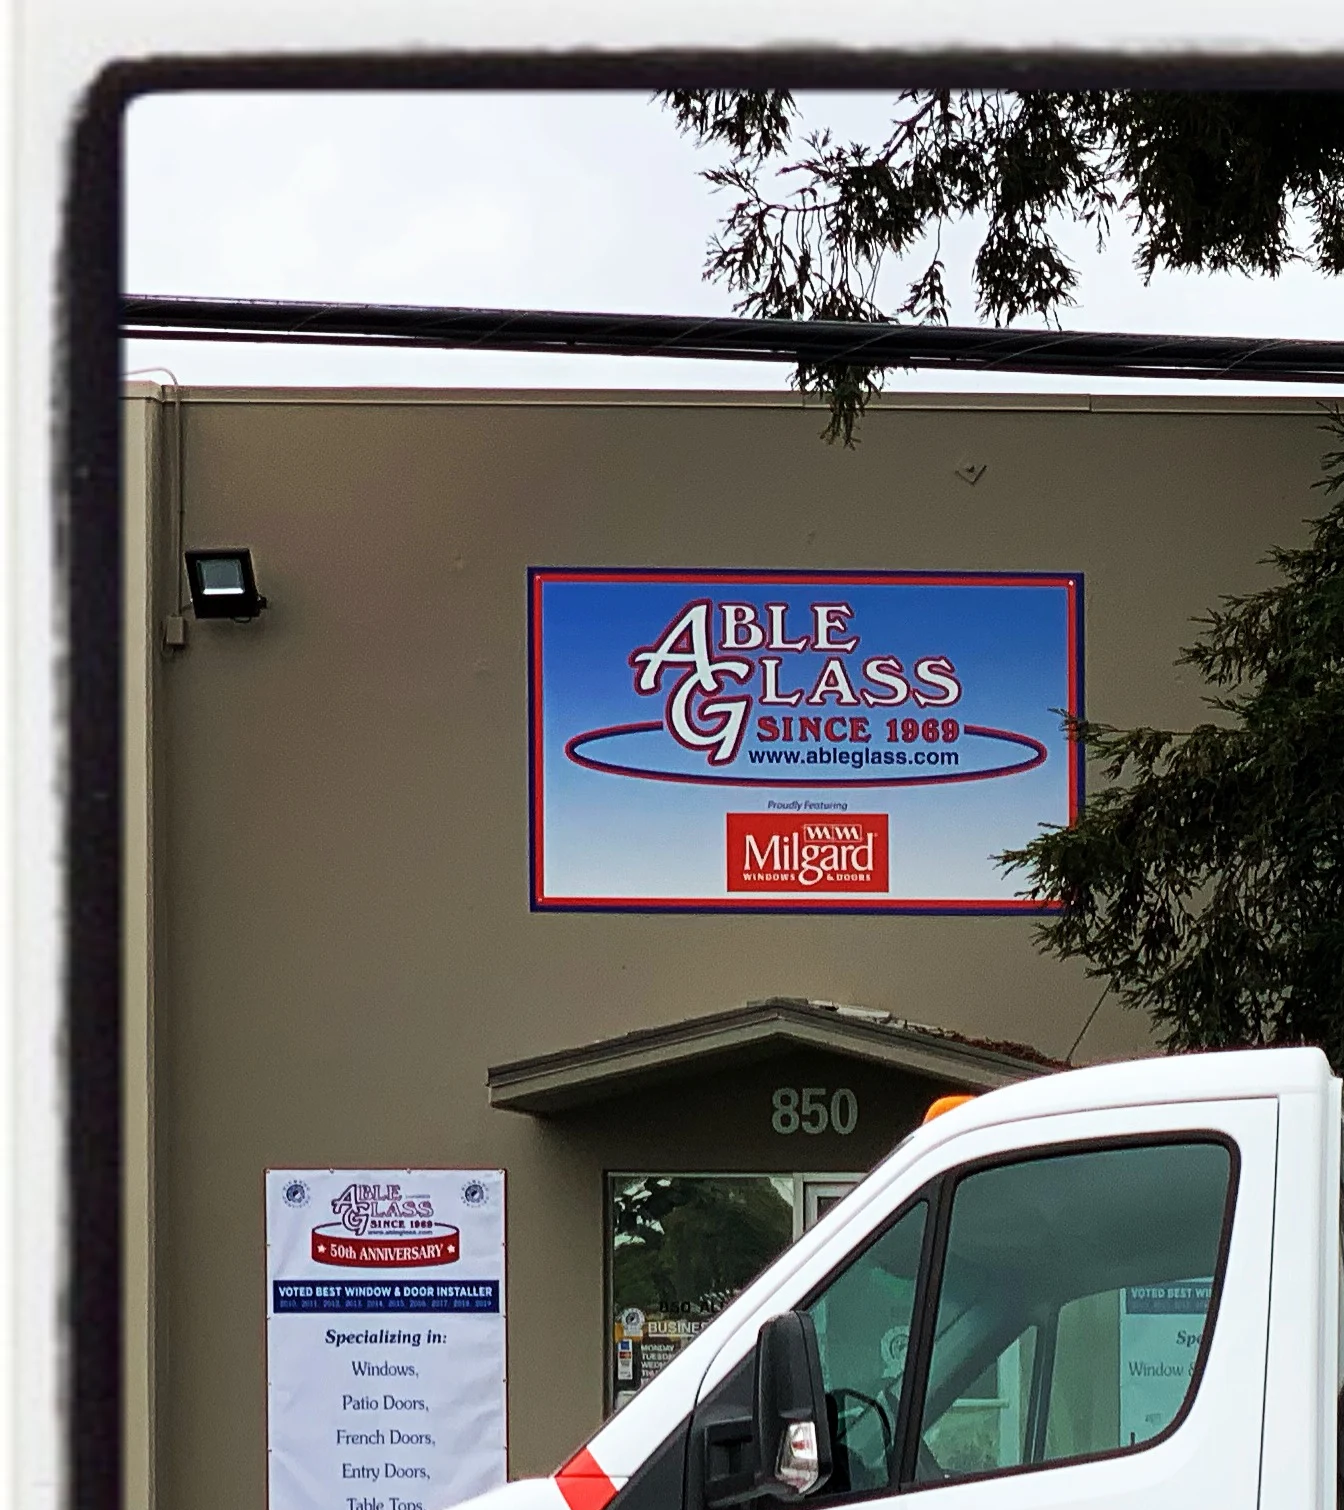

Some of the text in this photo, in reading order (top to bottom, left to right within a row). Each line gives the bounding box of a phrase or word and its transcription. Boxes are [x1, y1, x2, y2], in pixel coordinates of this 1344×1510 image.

[628, 598, 859, 695] ABLE
[666, 654, 962, 766] GLASS
[756, 716, 960, 743] SINCE 1969
[748, 747, 960, 768] www.ableglass.com
[767, 800, 848, 811] Proudly Featuring
[743, 832, 875, 886] Milgard
[743, 873, 796, 882] WINDOWS
[836, 874, 871, 882] DOORS
[771, 1087, 859, 1135] 850
[331, 1184, 402, 1214] ABLE
[342, 1201, 434, 1236] GLASS
[370, 1220, 433, 1229] SINCE 1969
[330, 1243, 444, 1262] 50th ANNIVERSARY
[278, 1286, 493, 1297] VOTED BEST WINDOW & DOOR INSTALLER
[1131, 1287, 1165, 1299] VOTED
[1167, 1288, 1191, 1298] BEST
[648, 1321, 707, 1333] BUSINE
[324, 1329, 448, 1348] Specializing in:
[352, 1360, 419, 1378] Windows,
[1129, 1361, 1184, 1377] Window
[342, 1394, 430, 1412] Patio Doors,
[336, 1429, 436, 1447] French Doors,
[342, 1463, 431, 1483] Entry Doors,
